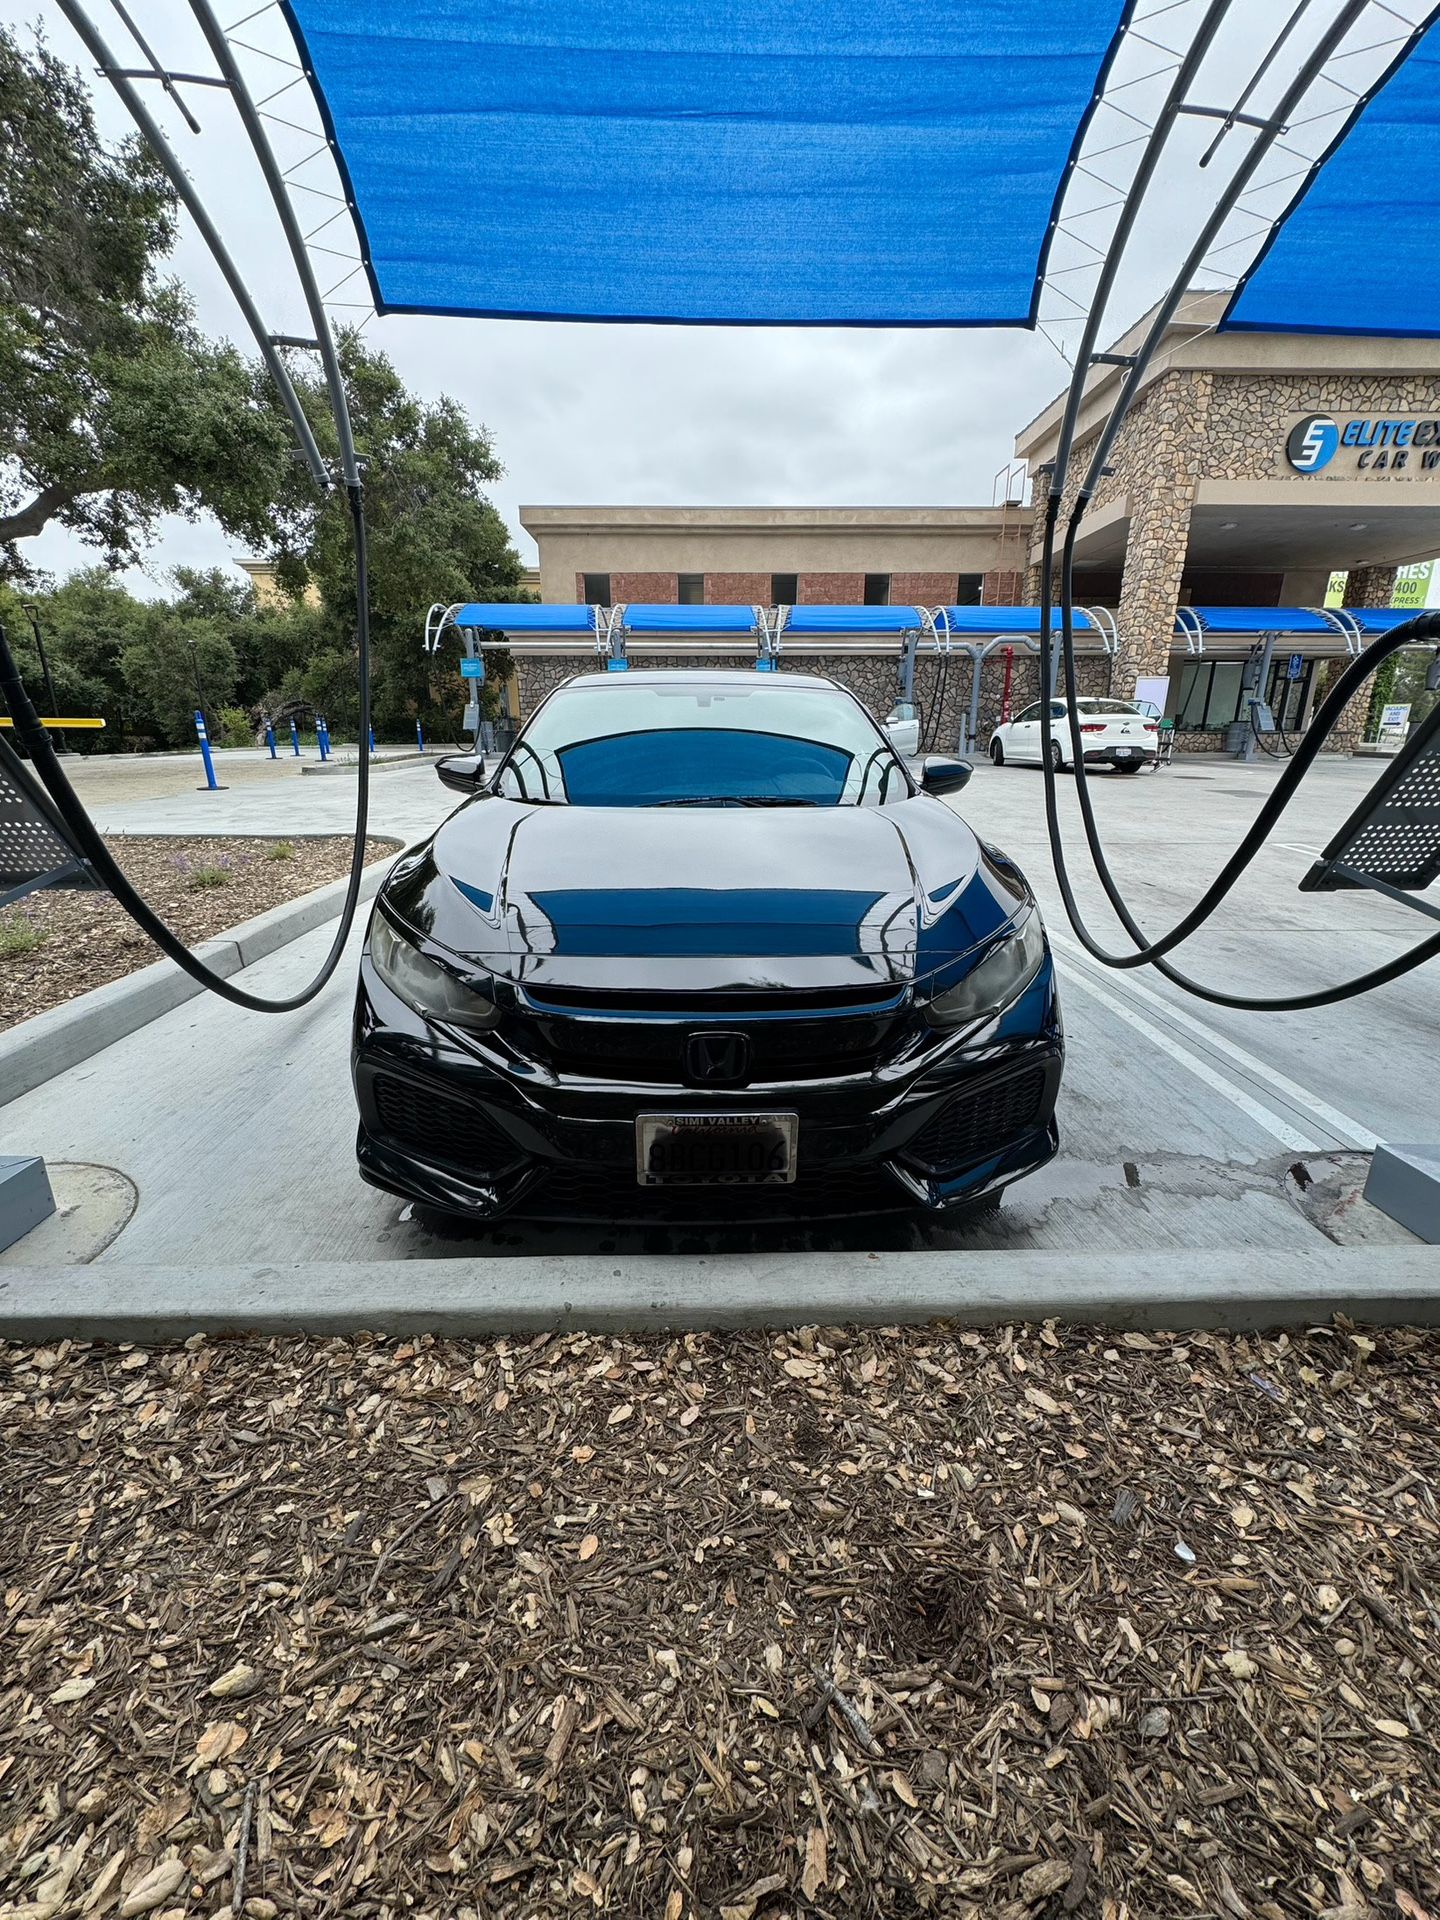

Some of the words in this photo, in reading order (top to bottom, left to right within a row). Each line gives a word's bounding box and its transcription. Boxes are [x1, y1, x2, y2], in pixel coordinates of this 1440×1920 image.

[1342, 420, 1416, 446] ELITE
[1358, 450, 1409, 469] CAR
[1395, 582, 1417, 594] 400
[1392, 597, 1419, 605] PRESS
[675, 1117, 704, 1126] SIMI
[708, 1117, 759, 1126] VALLEY
[648, 1174, 785, 1185] TOYOTA
